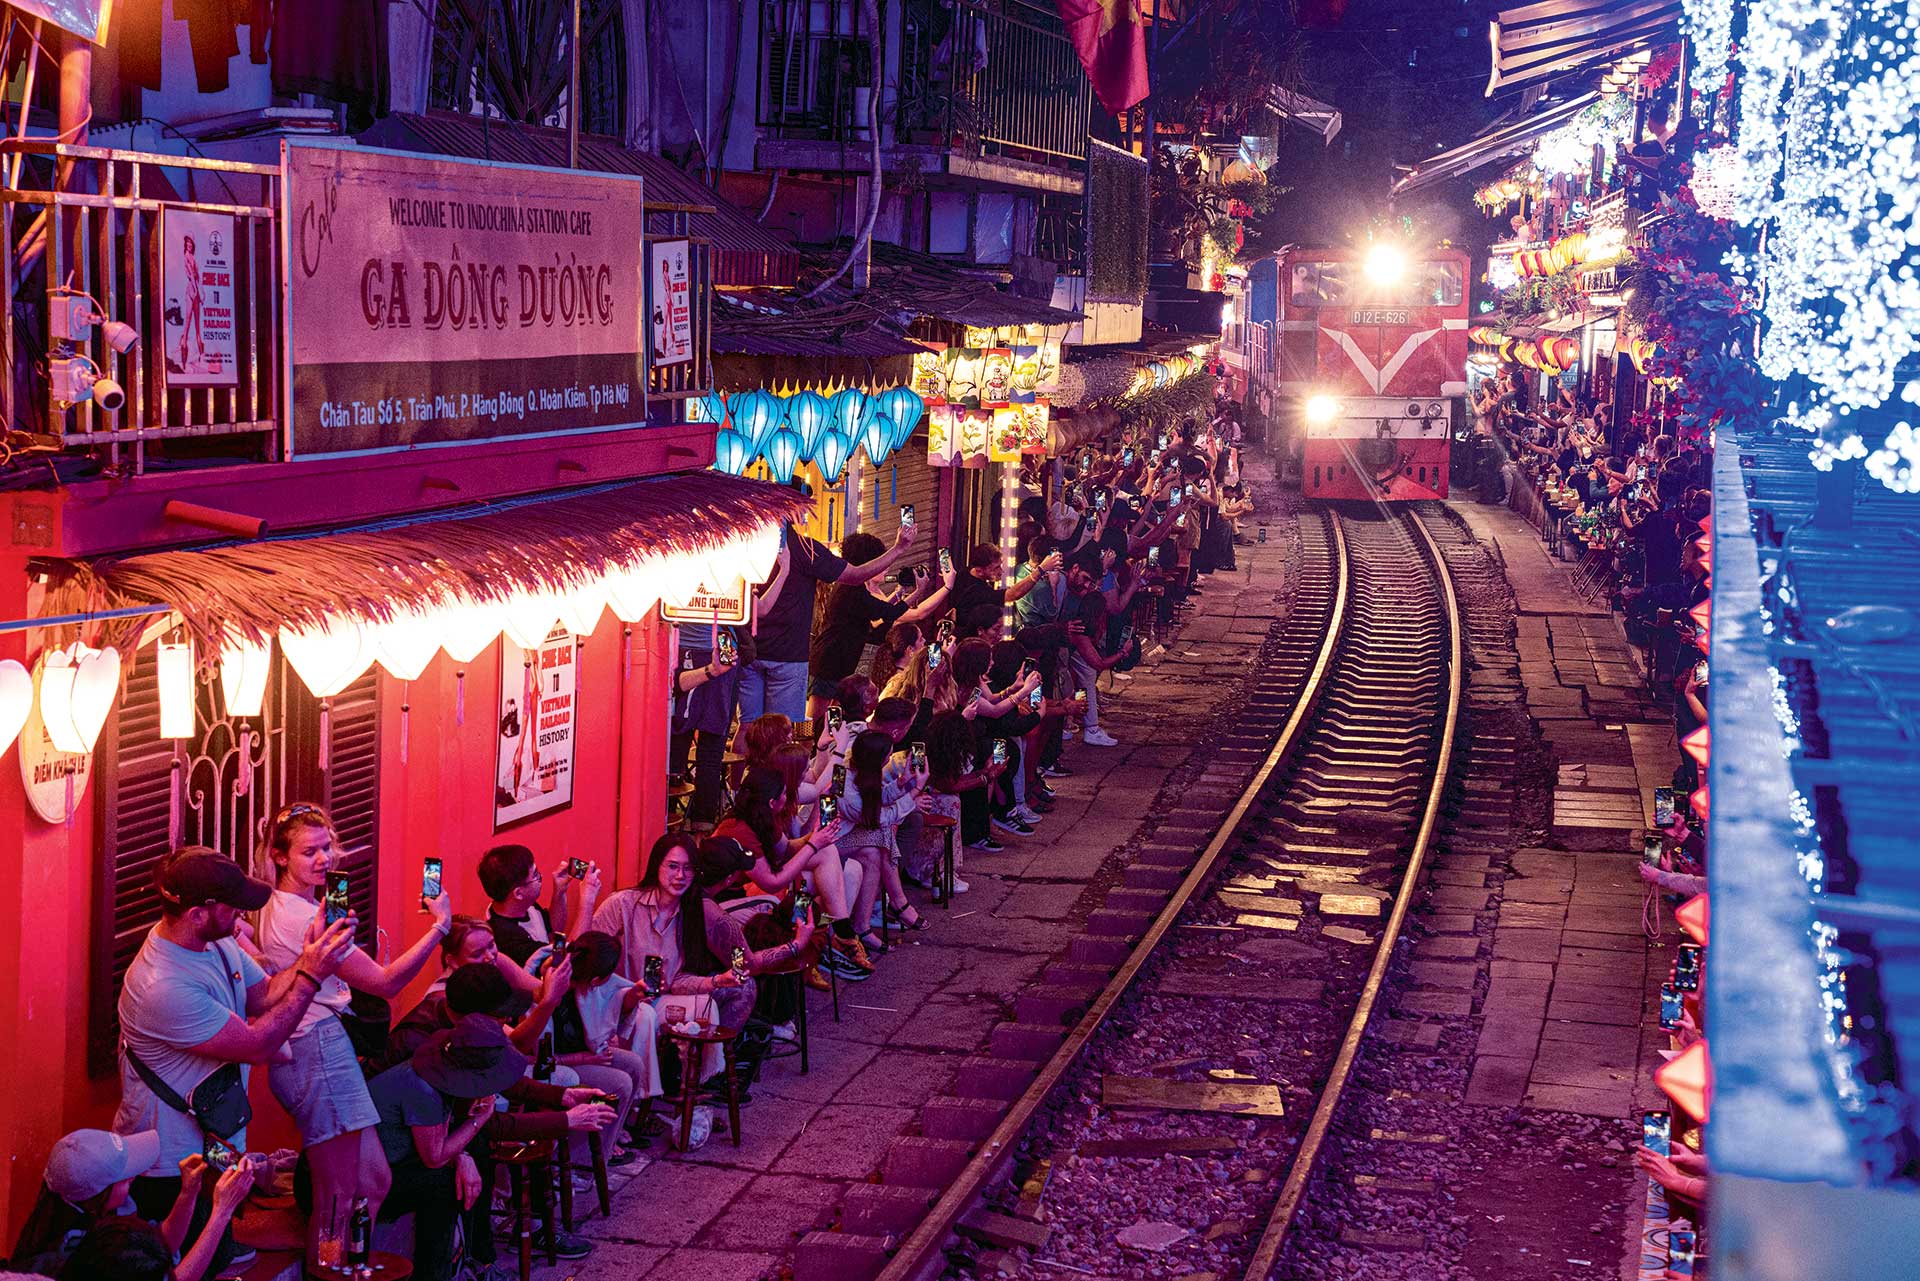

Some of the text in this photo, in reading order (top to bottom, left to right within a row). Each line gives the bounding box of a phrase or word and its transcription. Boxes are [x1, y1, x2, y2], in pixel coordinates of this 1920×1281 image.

[389, 197, 592, 236] WELCOME TO INDOCHINA STATION CAFE
[361, 258, 411, 330] GA
[518, 251, 614, 328] DƯƠNG
[203, 331, 231, 340] HISTORY
[352, 400, 375, 425] Tàu
[378, 396, 393, 425] Số
[395, 400, 406, 425] 5,
[408, 393, 433, 421] Trần
[435, 395, 458, 419] Phú,
[461, 394, 470, 417] P.
[472, 394, 498, 421] Hàng
[528, 389, 539, 411] Q.
[540, 388, 563, 411] Hoàn
[589, 384, 601, 413] Tp
[602, 384, 614, 405] Hà
[616, 383, 629, 408] Nội
[541, 694, 571, 714] VIETNAM
[539, 728, 570, 747] HISTORY
